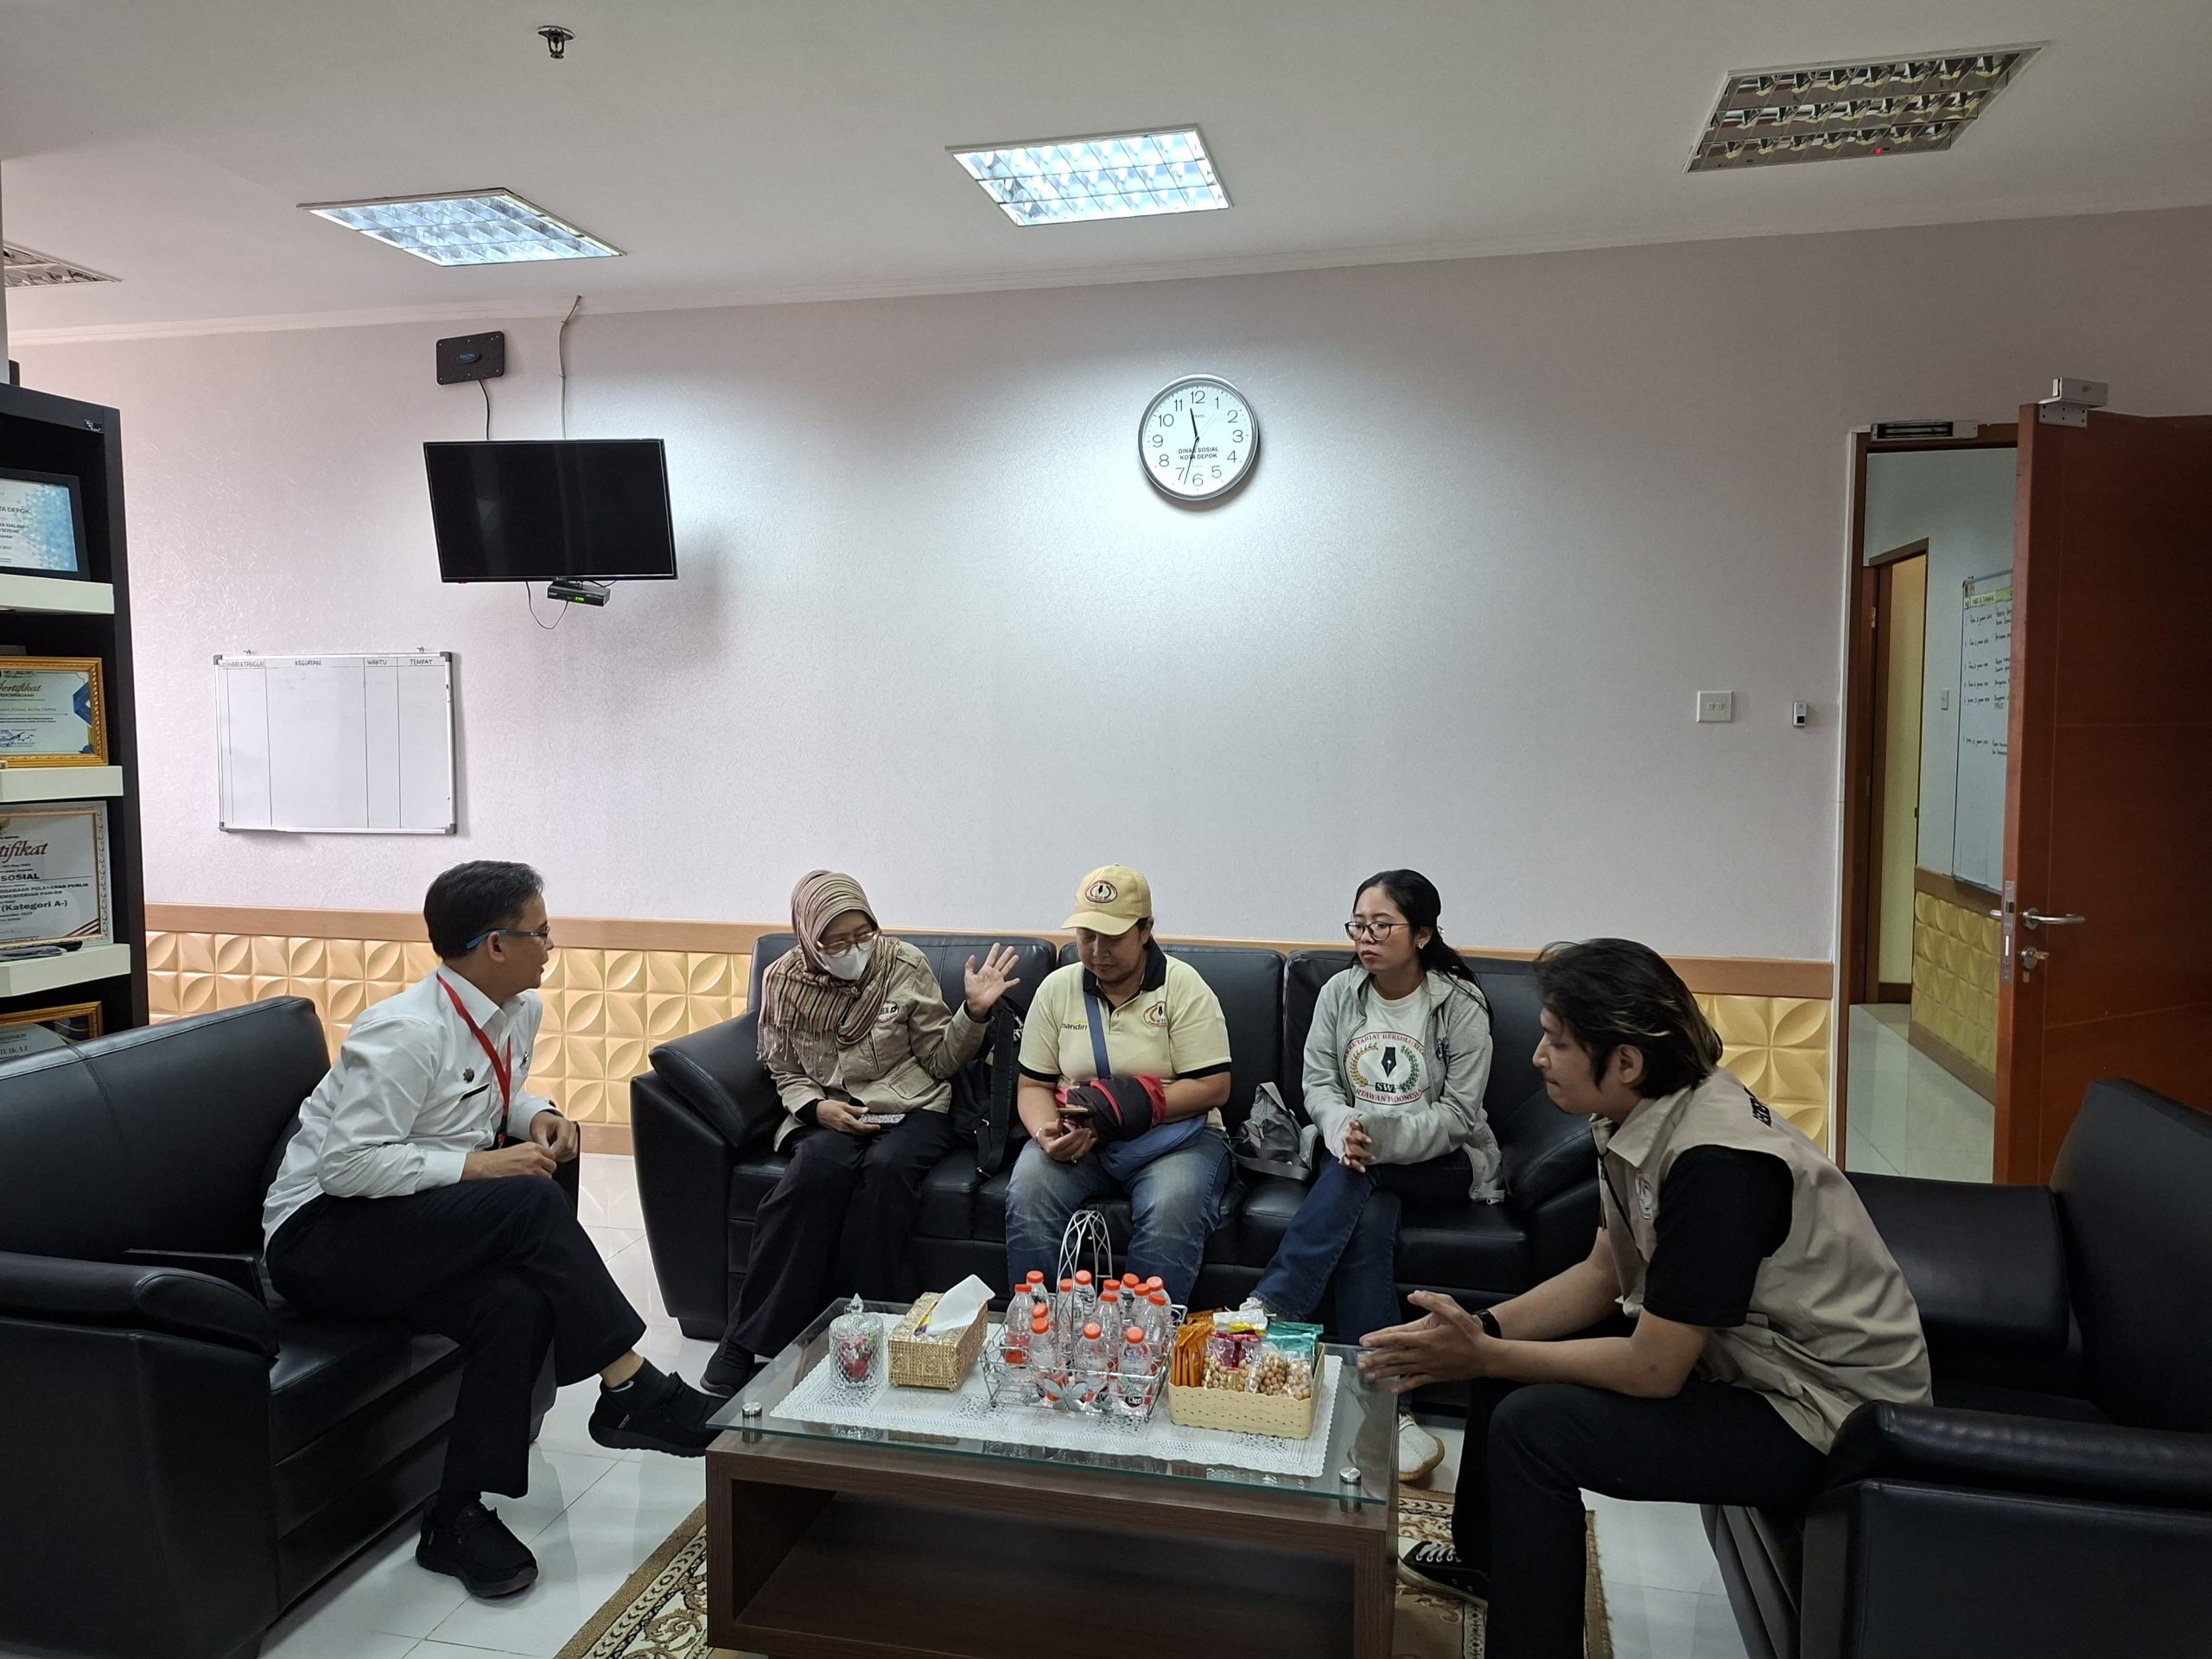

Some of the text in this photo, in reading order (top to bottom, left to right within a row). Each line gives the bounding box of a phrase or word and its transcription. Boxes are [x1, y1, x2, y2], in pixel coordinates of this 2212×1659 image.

[1190, 391, 1206, 404] 12
[1215, 397, 1219, 410] 1
[1173, 398, 1183, 412] 11
[1158, 414, 1174, 428] 10
[1227, 410, 1238, 423] 2
[1152, 435, 1164, 448] 9
[1232, 429, 1243, 442] 3
[1159, 454, 1170, 467] 8
[1226, 450, 1237, 463] 4
[1175, 467, 1185, 480] 7
[1211, 465, 1222, 479] 5
[1192, 474, 1204, 486] 6
[0, 840, 48, 863] tifikat
[1, 873, 41, 881] SOSIAL
[1, 901, 51, 912] (Kategori
[1356, 1089, 1386, 1103] RTAWAN
